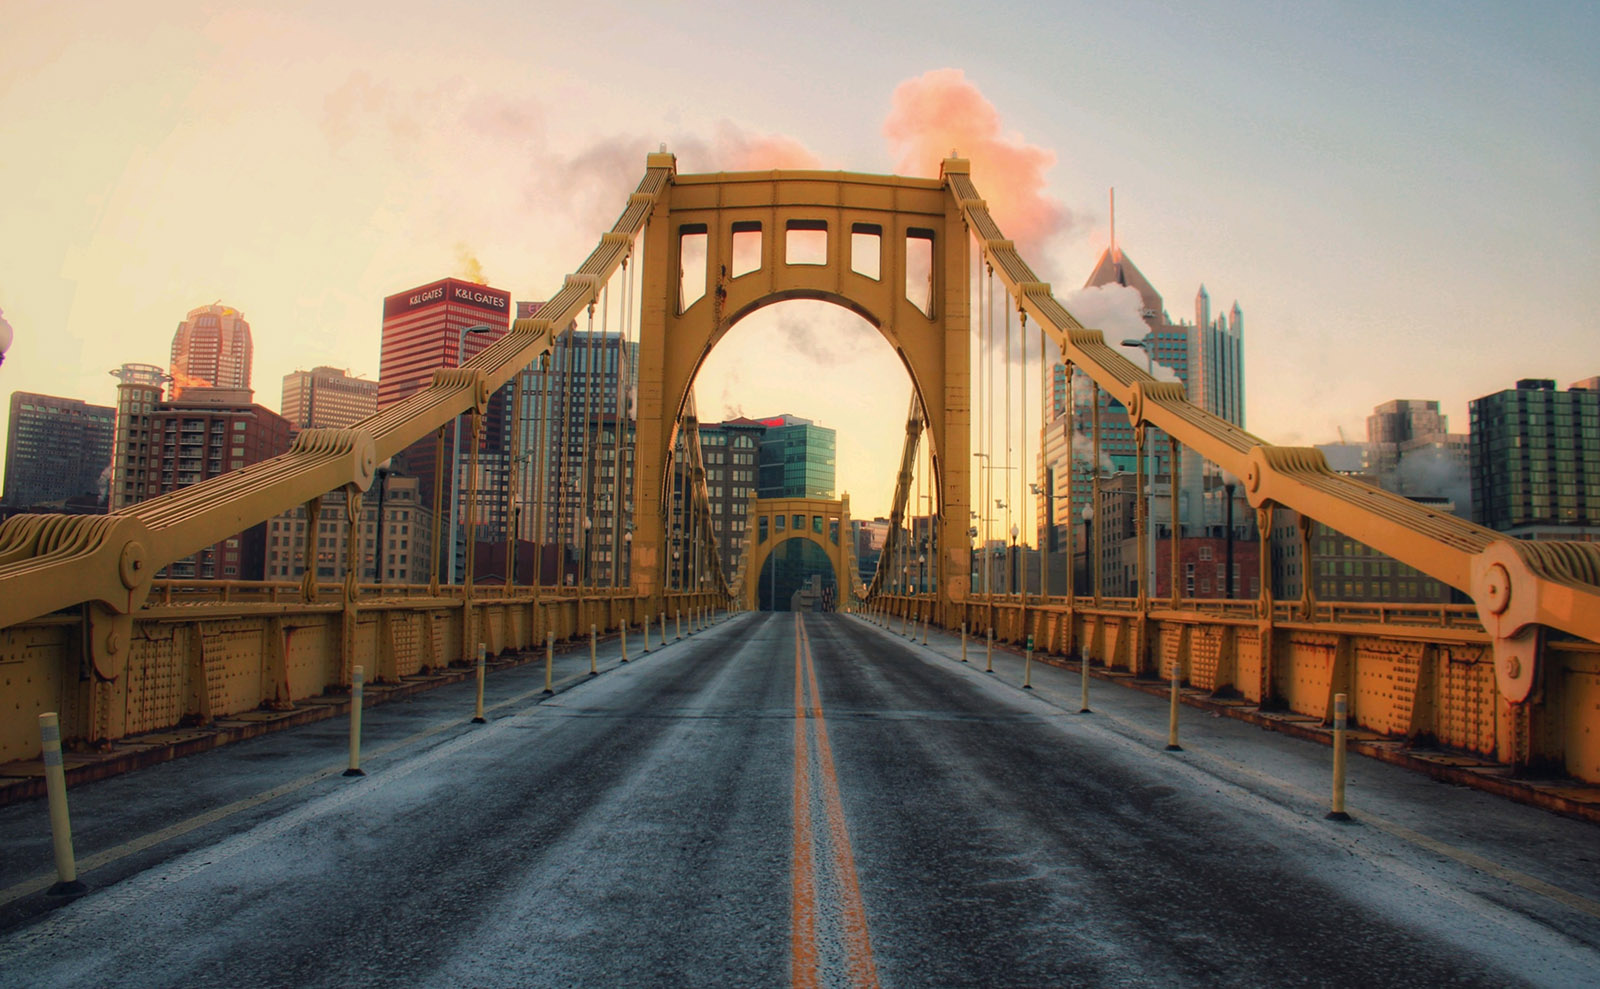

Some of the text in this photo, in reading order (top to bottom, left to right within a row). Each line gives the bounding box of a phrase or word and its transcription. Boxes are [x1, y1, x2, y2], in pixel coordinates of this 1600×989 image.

[410, 288, 443, 306] K&L GATES
[455, 288, 505, 308] K&L GATES
